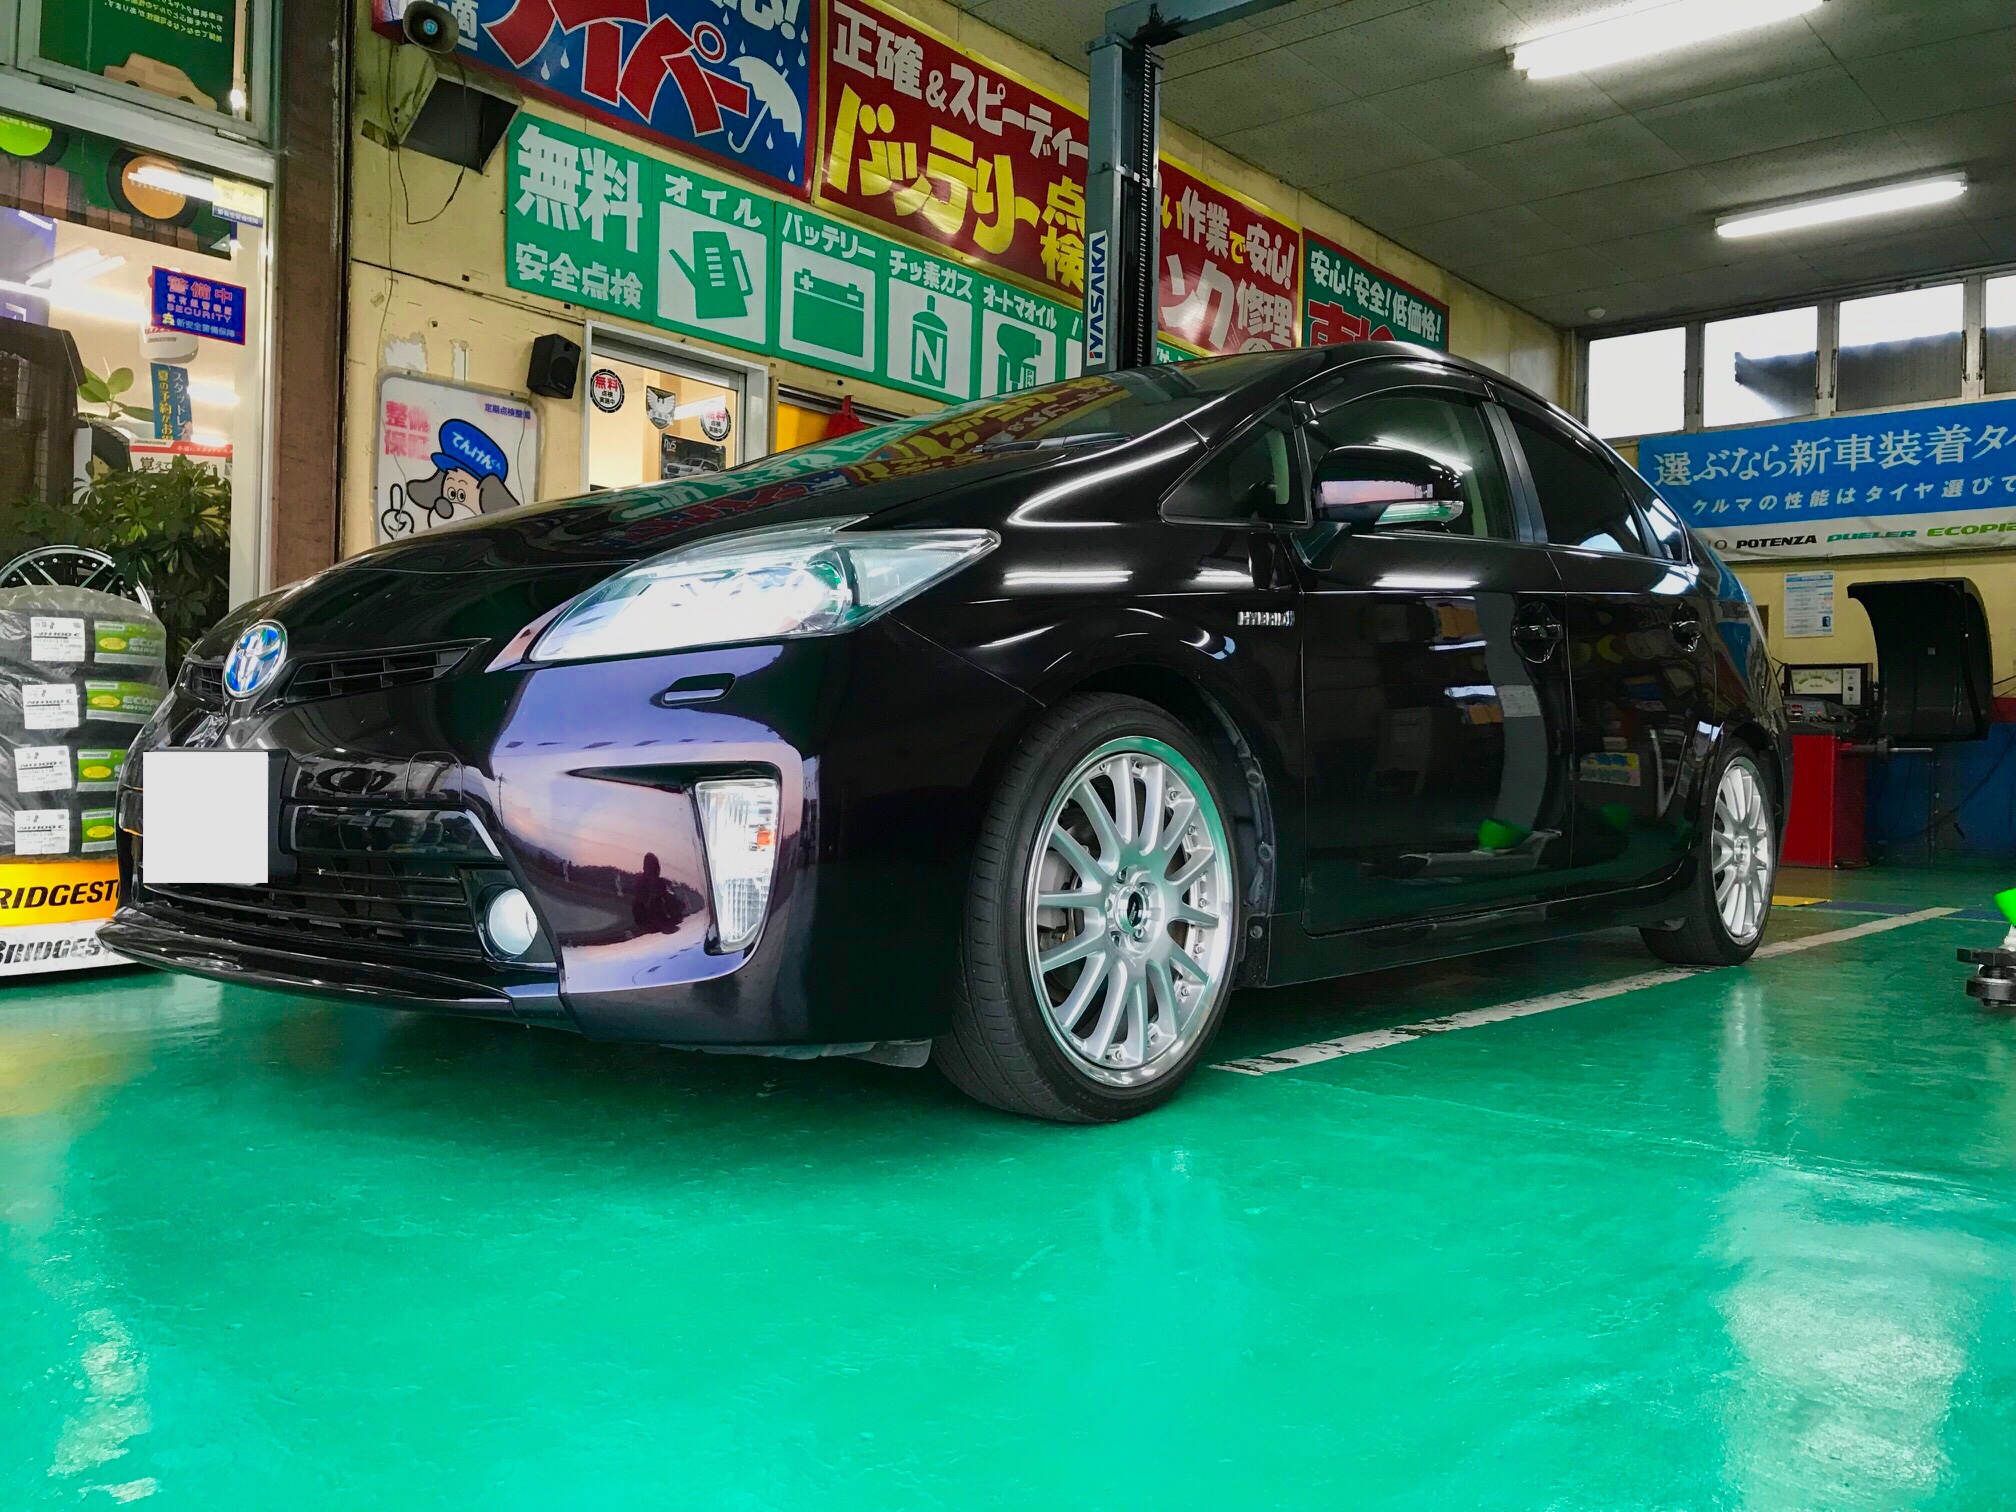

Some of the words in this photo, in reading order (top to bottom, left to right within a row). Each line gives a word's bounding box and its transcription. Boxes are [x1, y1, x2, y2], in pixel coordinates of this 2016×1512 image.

[515, 123, 643, 254] 無料
[826, 83, 1041, 255] バッテリー
[665, 173, 762, 228] オイル
[782, 211, 876, 260] バッテリー
[167, 275, 233, 304] 警備中
[515, 241, 643, 311] 安全点検
[888, 250, 973, 300] チッ素ガス
[166, 302, 232, 324] SECURITY
[982, 284, 1057, 330] オートマオイル
[594, 374, 619, 392] 無料
[385, 400, 430, 433] 整備
[484, 403, 531, 420] 定期点検整備
[1736, 535, 1817, 549] POTENZA
[1827, 529, 1917, 543] DUELER
[0, 879, 119, 910] RIDGEST
